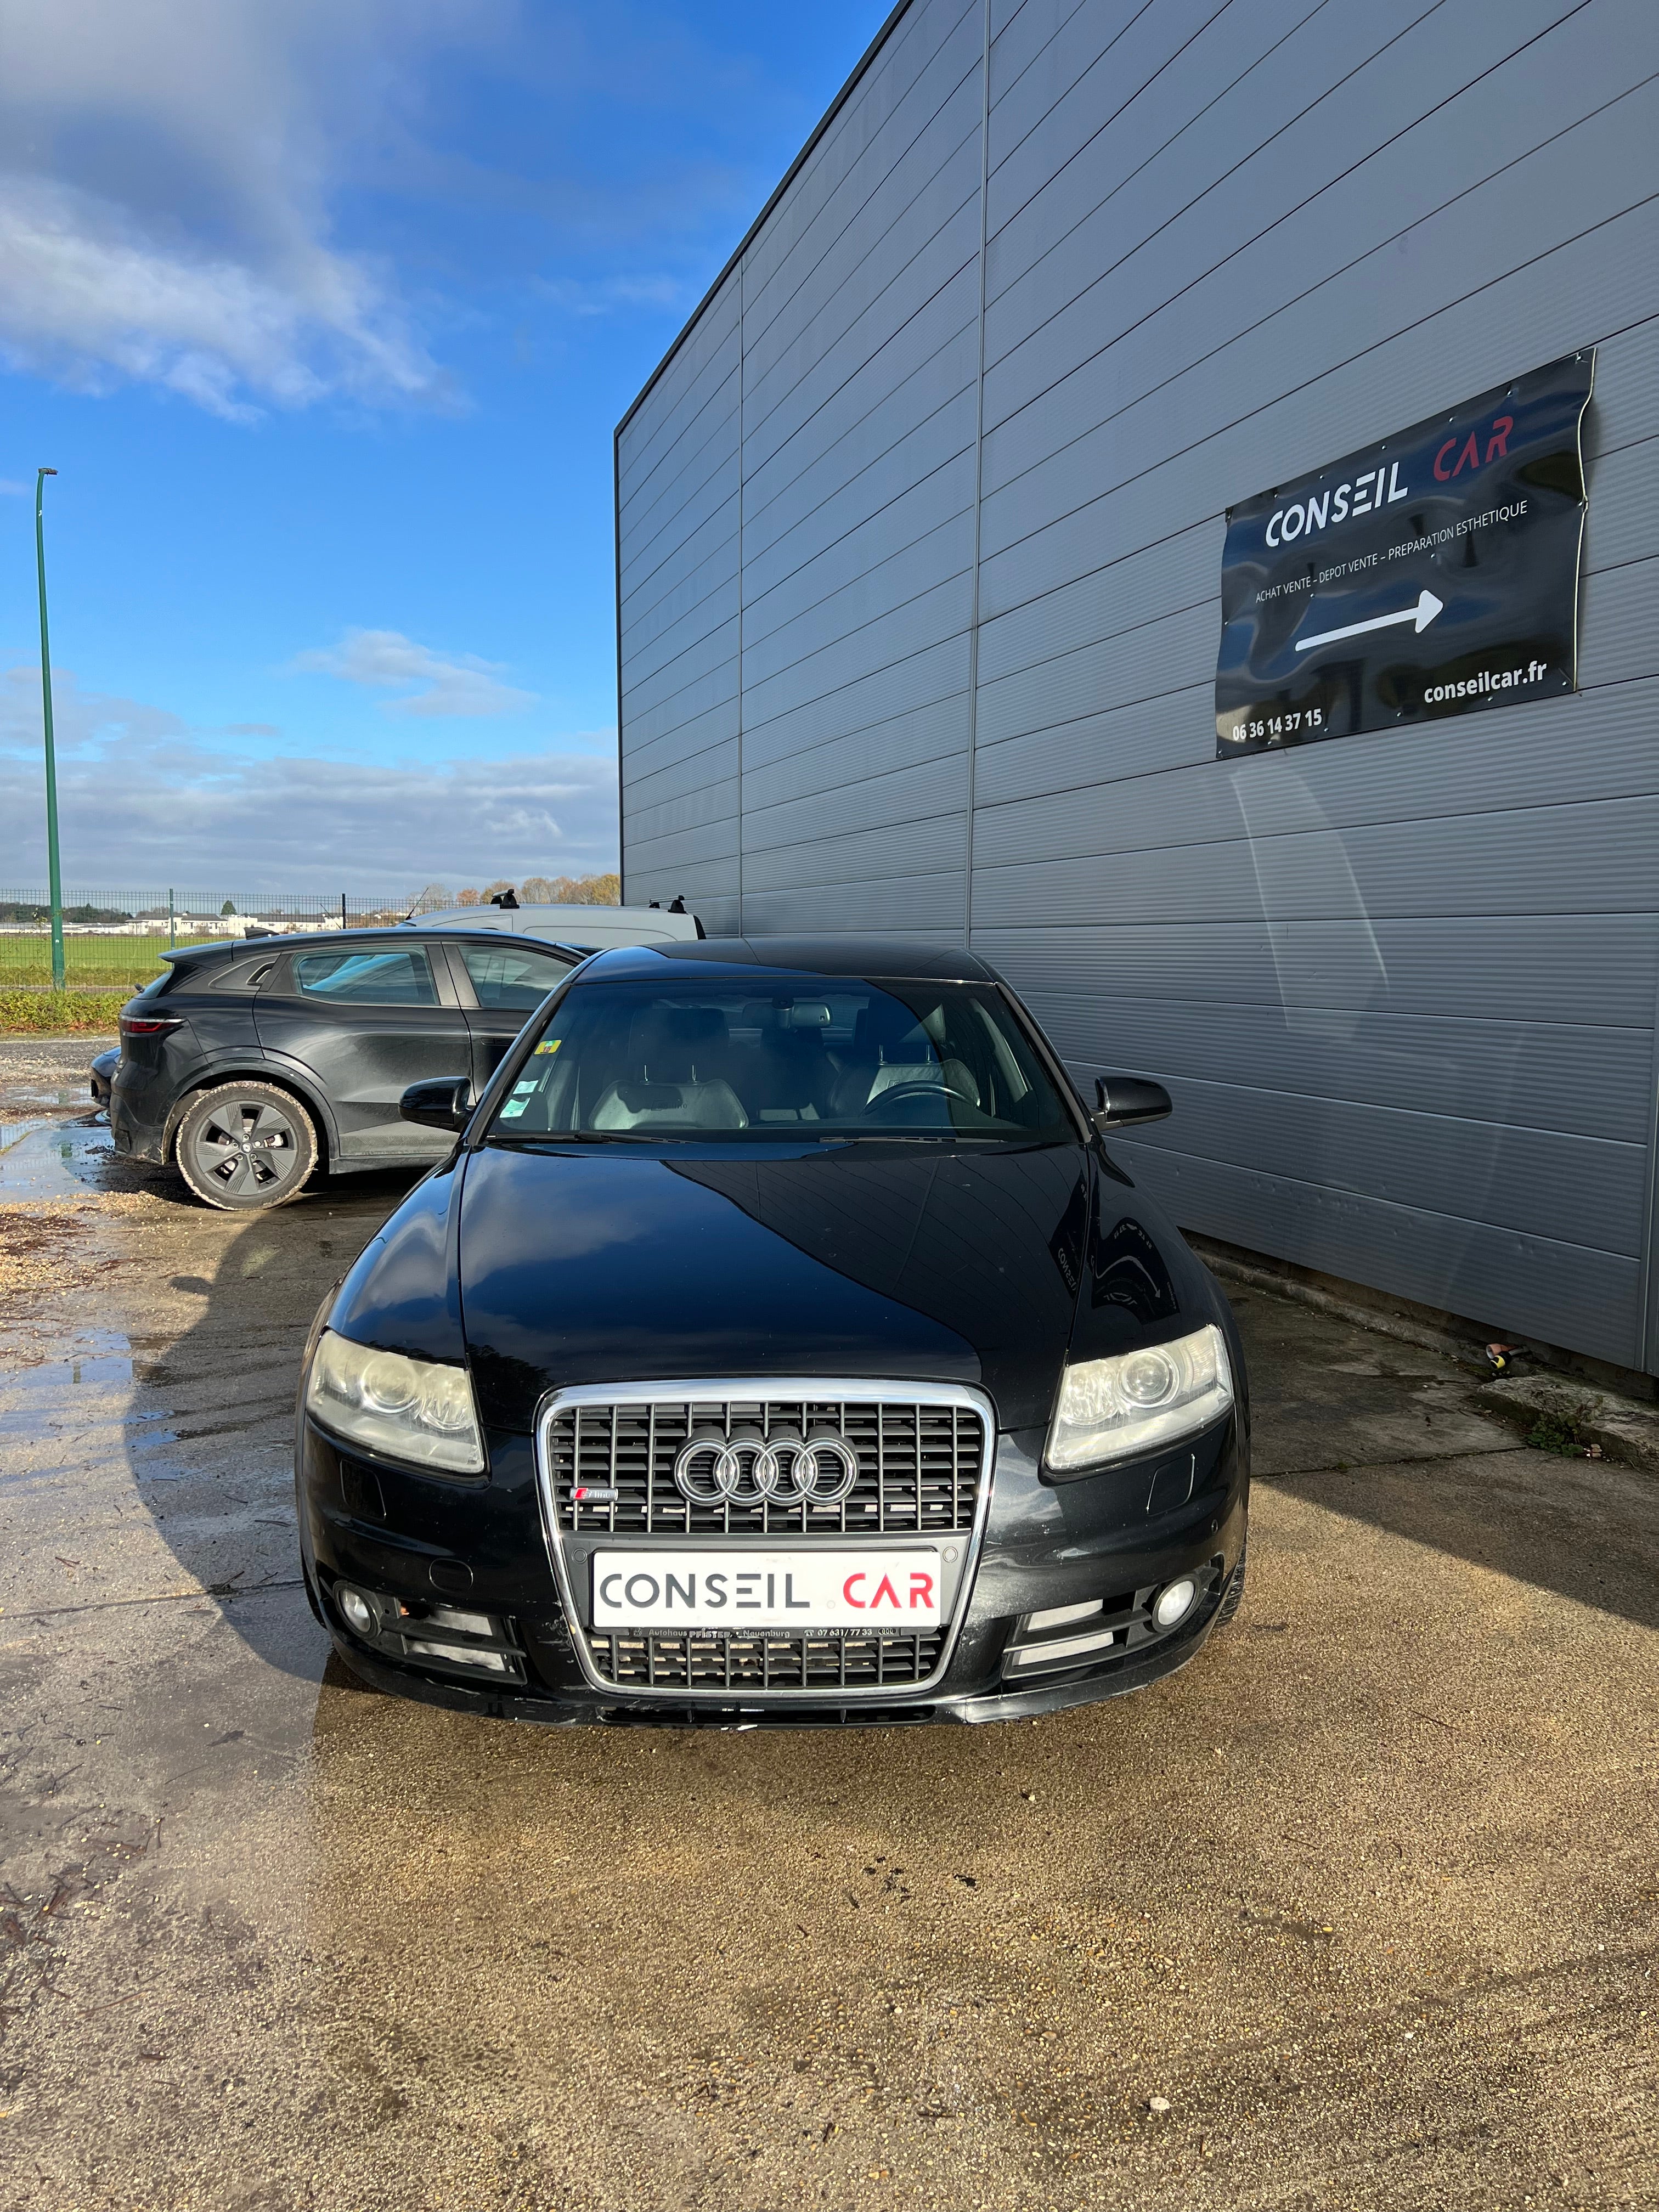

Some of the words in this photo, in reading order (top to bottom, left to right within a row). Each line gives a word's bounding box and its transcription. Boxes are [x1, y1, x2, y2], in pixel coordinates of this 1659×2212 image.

[1265, 461, 1408, 548] CONSEIL
[1433, 415, 1514, 482] CAR
[1255, 585, 1282, 603] ACHAT
[1283, 576, 1312, 594] VENTE
[1319, 563, 1347, 584] DEPOT
[1348, 553, 1378, 573] VENTE
[1388, 528, 1454, 560] PREPARATION
[1456, 500, 1528, 536] ESTHETIQUE
[1424, 660, 1548, 703] conseilcar.fr
[1232, 724, 1247, 741] 06
[1249, 720, 1265, 737] 36
[1267, 717, 1283, 734] 14
[1285, 713, 1301, 731] 37
[1305, 708, 1323, 727] 15
[599, 1573, 810, 1609] CONSEIL
[842, 1572, 935, 1609] CAR
[648, 1628, 688, 1637] Autohaus
[817, 1628, 828, 1637] 07
